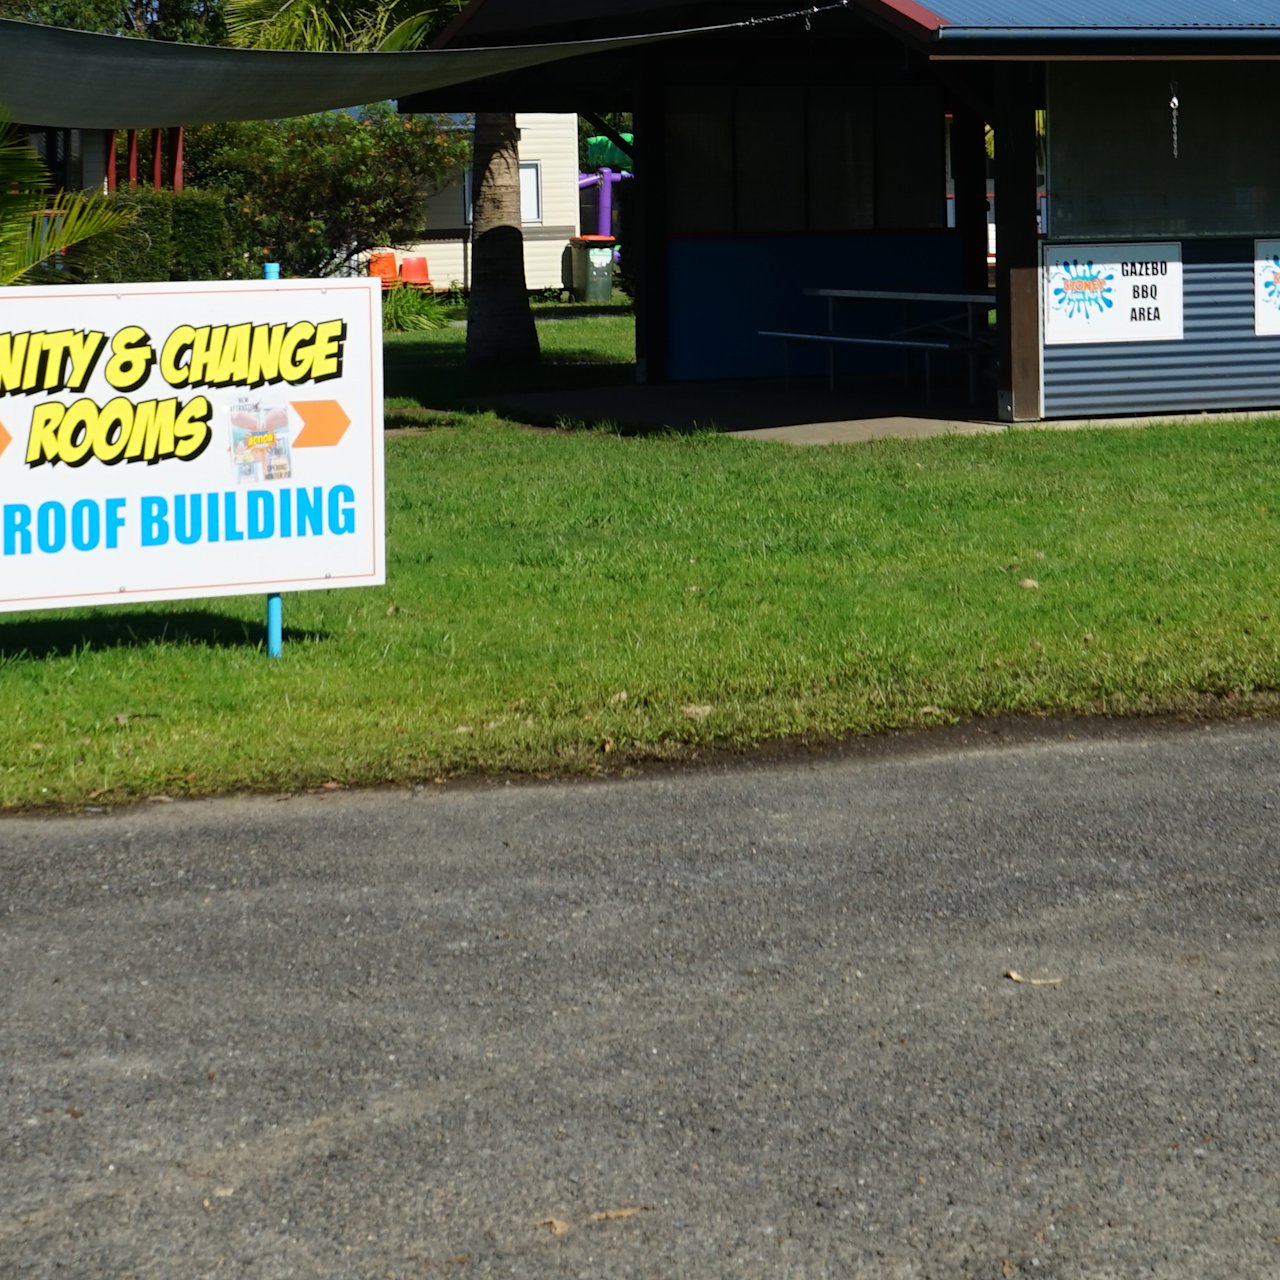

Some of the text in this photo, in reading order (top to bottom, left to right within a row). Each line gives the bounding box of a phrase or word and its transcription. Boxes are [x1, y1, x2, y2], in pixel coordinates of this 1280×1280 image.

[1121, 261, 1167, 276] GAZEBO
[1133, 284, 1157, 300] BBQ
[1131, 307, 1161, 322] AREA
[104, 325, 156, 391] &
[160, 318, 347, 387] CHANGE
[25, 395, 212, 469] ROOMS
[2, 497, 127, 556] ROOF
[140, 484, 356, 547] BUILDING
